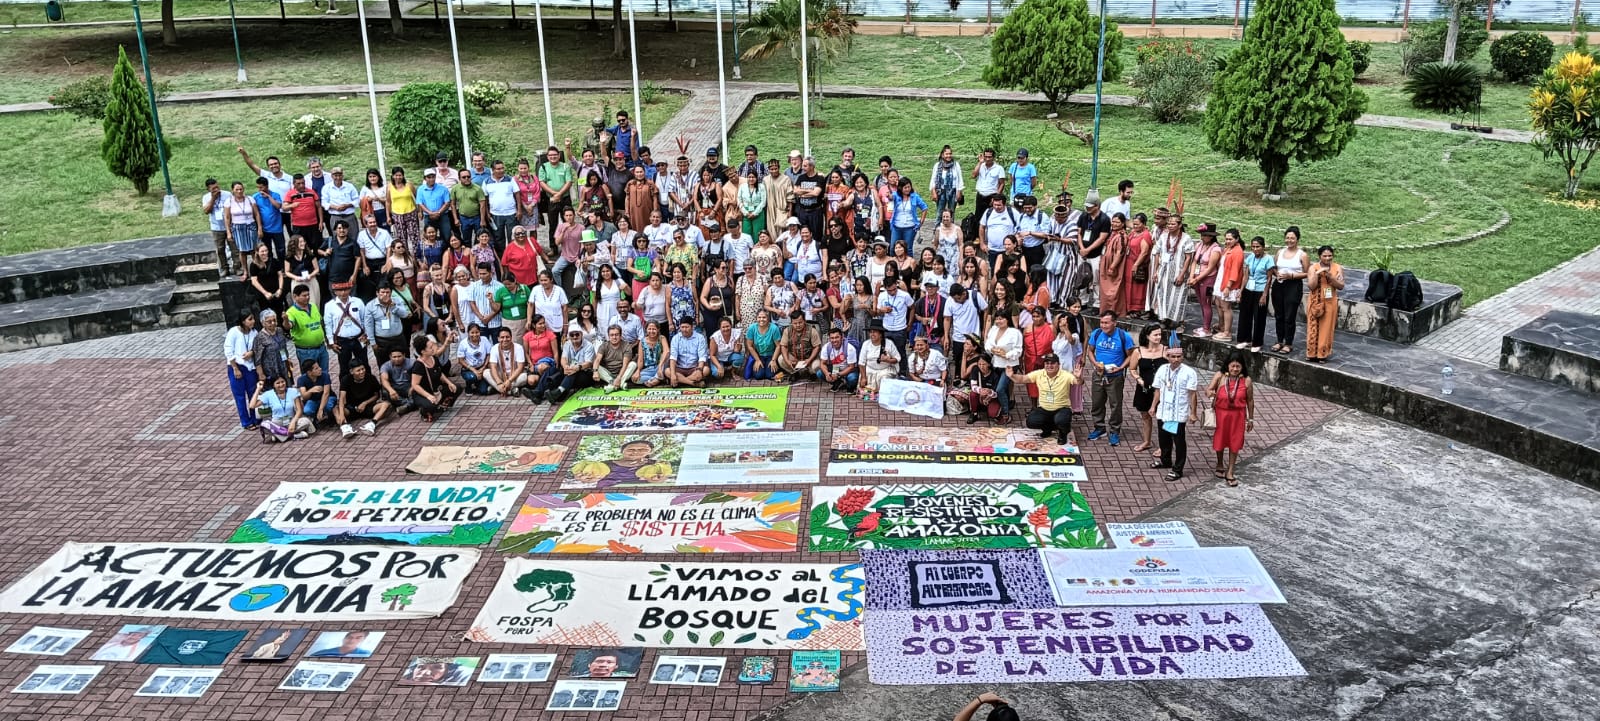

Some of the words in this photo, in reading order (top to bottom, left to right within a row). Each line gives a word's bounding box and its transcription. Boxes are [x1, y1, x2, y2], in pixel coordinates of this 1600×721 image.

[954, 454, 1076, 464] DESIGUALDAD
[363, 490, 386, 504] A
[388, 488, 422, 504] LA
[910, 496, 985, 508] JÓVENES
[282, 508, 331, 523] NO
[332, 510, 352, 520] AL
[352, 504, 488, 522] PETRÓLEO
[562, 512, 580, 522] EL
[586, 508, 652, 521] PROBLEMA
[656, 509, 676, 520] NO
[680, 508, 698, 520] ES
[702, 508, 715, 520] EL
[721, 506, 758, 519] CLIMA
[886, 506, 1018, 518] RESISTIENDO
[564, 522, 587, 533] ES
[591, 521, 612, 532] EL
[884, 524, 1022, 538] AMAZONÍA
[61, 546, 380, 578] ACTUEMOS
[380, 551, 460, 579] POR
[676, 568, 782, 582] VAMOS
[22, 576, 88, 606] LA
[628, 584, 771, 601] LLAMADO
[496, 616, 553, 627] FOSPA
[638, 606, 780, 630] BOSQUE
[912, 611, 1115, 633] MUJERES
[1134, 614, 1191, 626] POR
[1200, 611, 1242, 625] LA
[902, 634, 1254, 656] SOSTENIBILIDAD
[936, 660, 976, 676] DE
[1004, 660, 1048, 676] LA
[1078, 656, 1184, 676] VIDA
